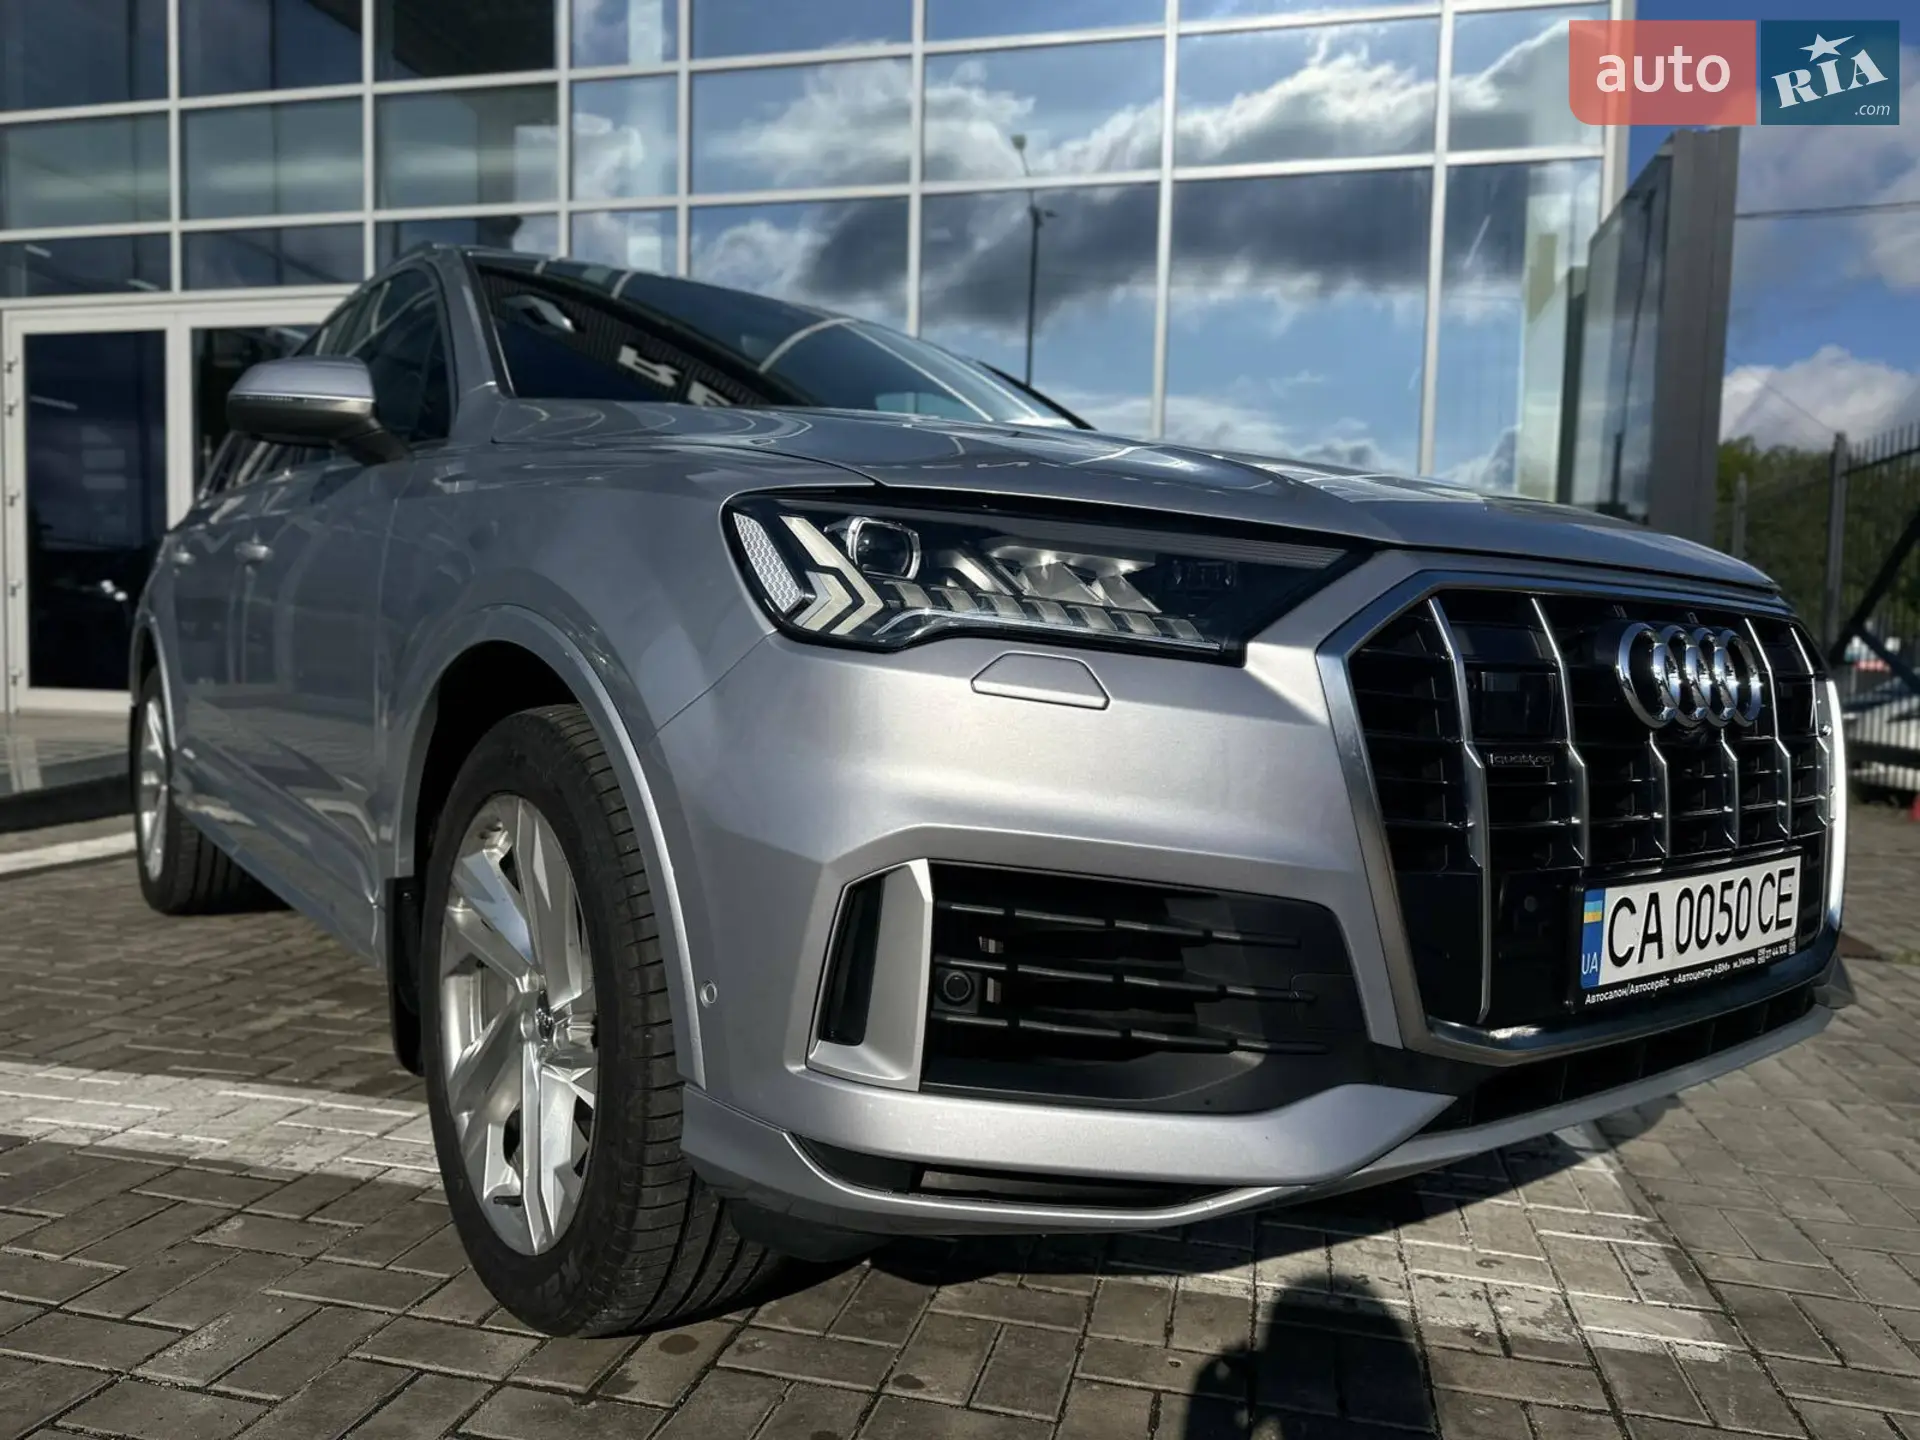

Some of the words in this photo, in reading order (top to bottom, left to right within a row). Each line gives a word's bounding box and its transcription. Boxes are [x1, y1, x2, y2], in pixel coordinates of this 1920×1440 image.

[1607, 891, 1664, 968] CA
[1675, 876, 1752, 955] 0050
[1758, 867, 1796, 934] CE
[1581, 951, 1599, 975] UA
